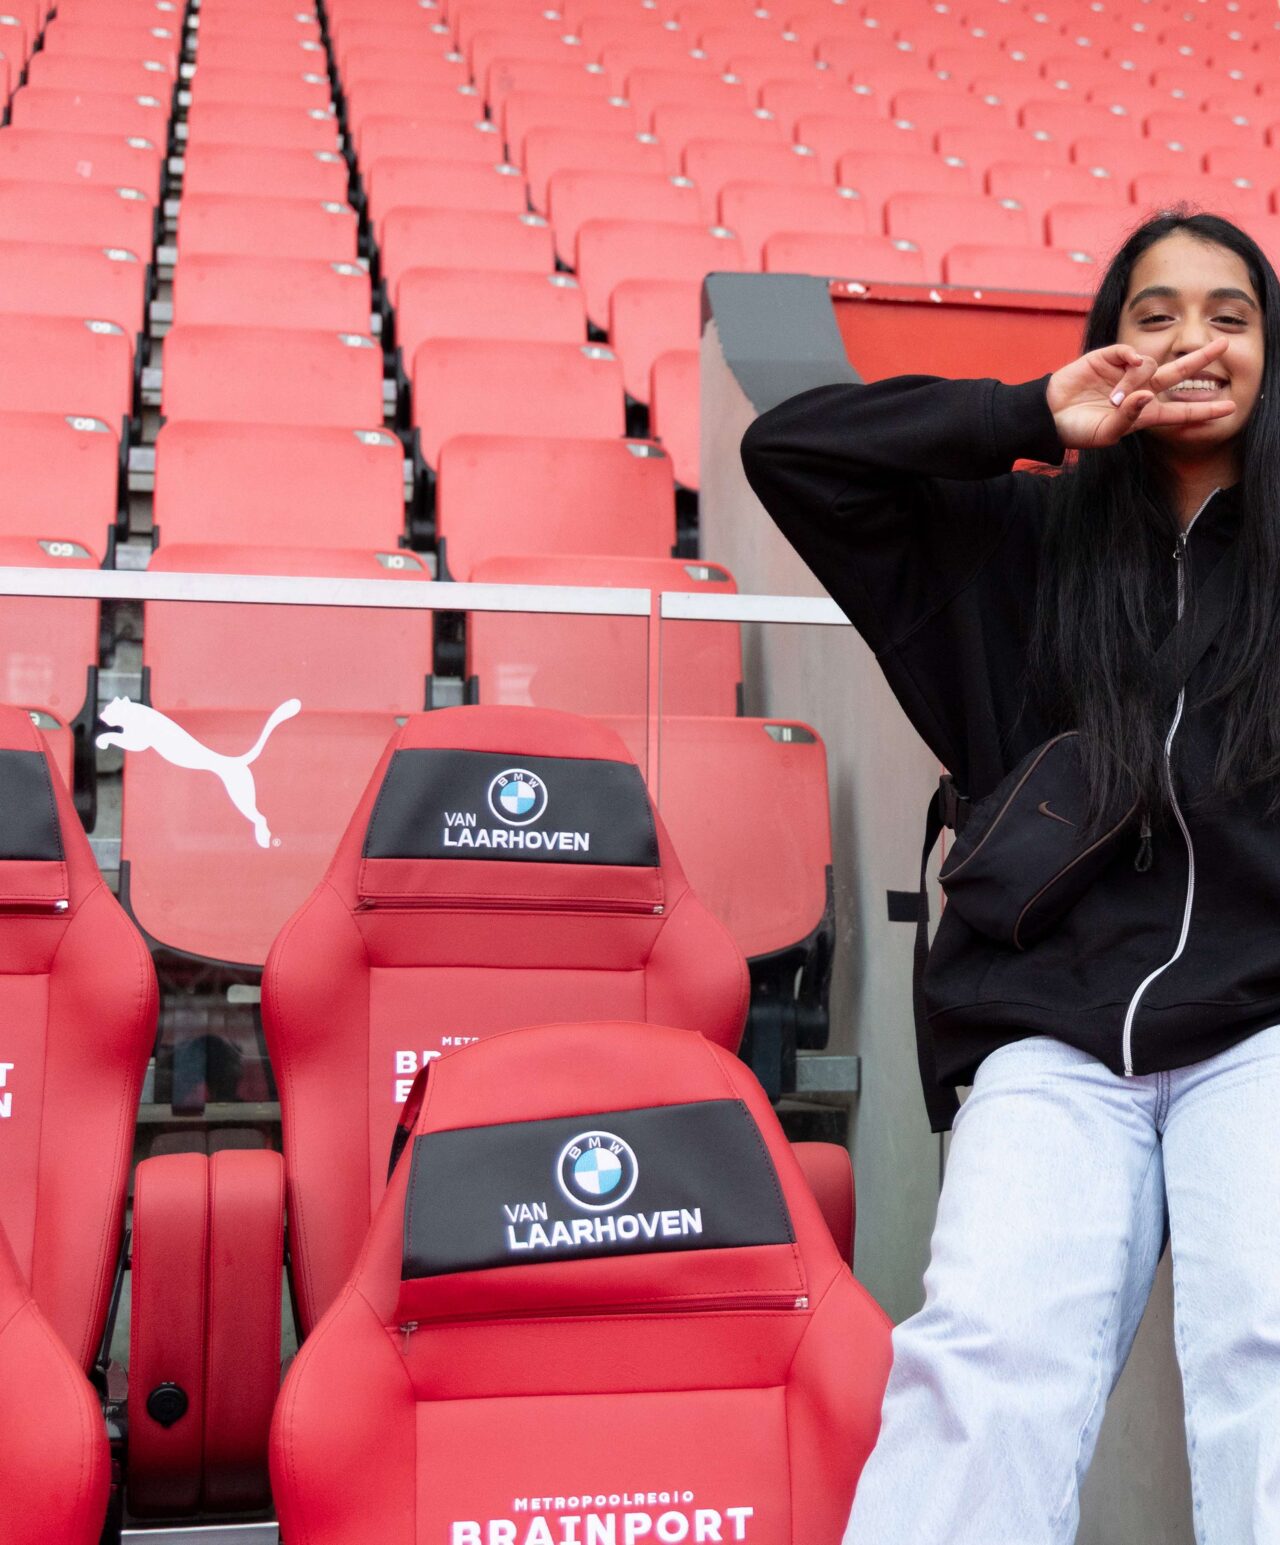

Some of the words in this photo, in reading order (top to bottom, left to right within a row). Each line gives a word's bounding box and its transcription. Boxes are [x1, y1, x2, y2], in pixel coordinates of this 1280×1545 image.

[49, 542, 73, 557] 09
[387, 556, 405, 569] 10
[498, 773, 539, 788] BMW
[445, 812, 476, 827] VAN
[444, 828, 590, 851] LAARHOVEN
[568, 1136, 624, 1160] BMW
[504, 1202, 548, 1223] VAN
[509, 1208, 703, 1250] LAARHOVEN
[514, 1490, 694, 1511] METROPOOLREGIO
[451, 1507, 754, 1545] BRAINPORT
